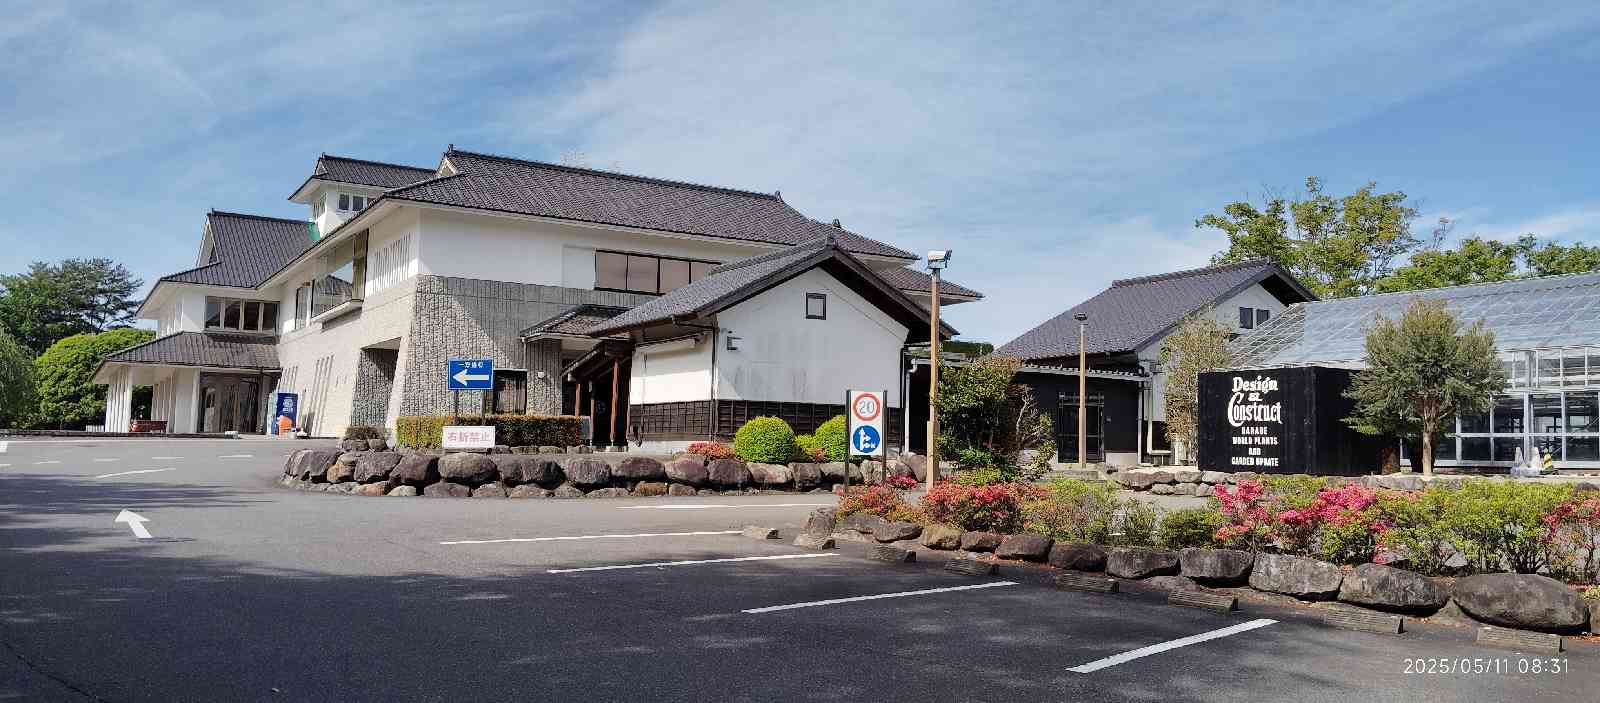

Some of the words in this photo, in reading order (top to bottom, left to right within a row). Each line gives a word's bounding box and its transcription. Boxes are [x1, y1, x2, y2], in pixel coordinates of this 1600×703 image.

[1231, 375, 1279, 394] Design
[859, 400, 875, 414] 20
[1227, 391, 1283, 427] Construct
[1232, 436, 1253, 445] WORLD
[1254, 436, 1278, 446] PLANTS
[1248, 447, 1261, 456] AND
